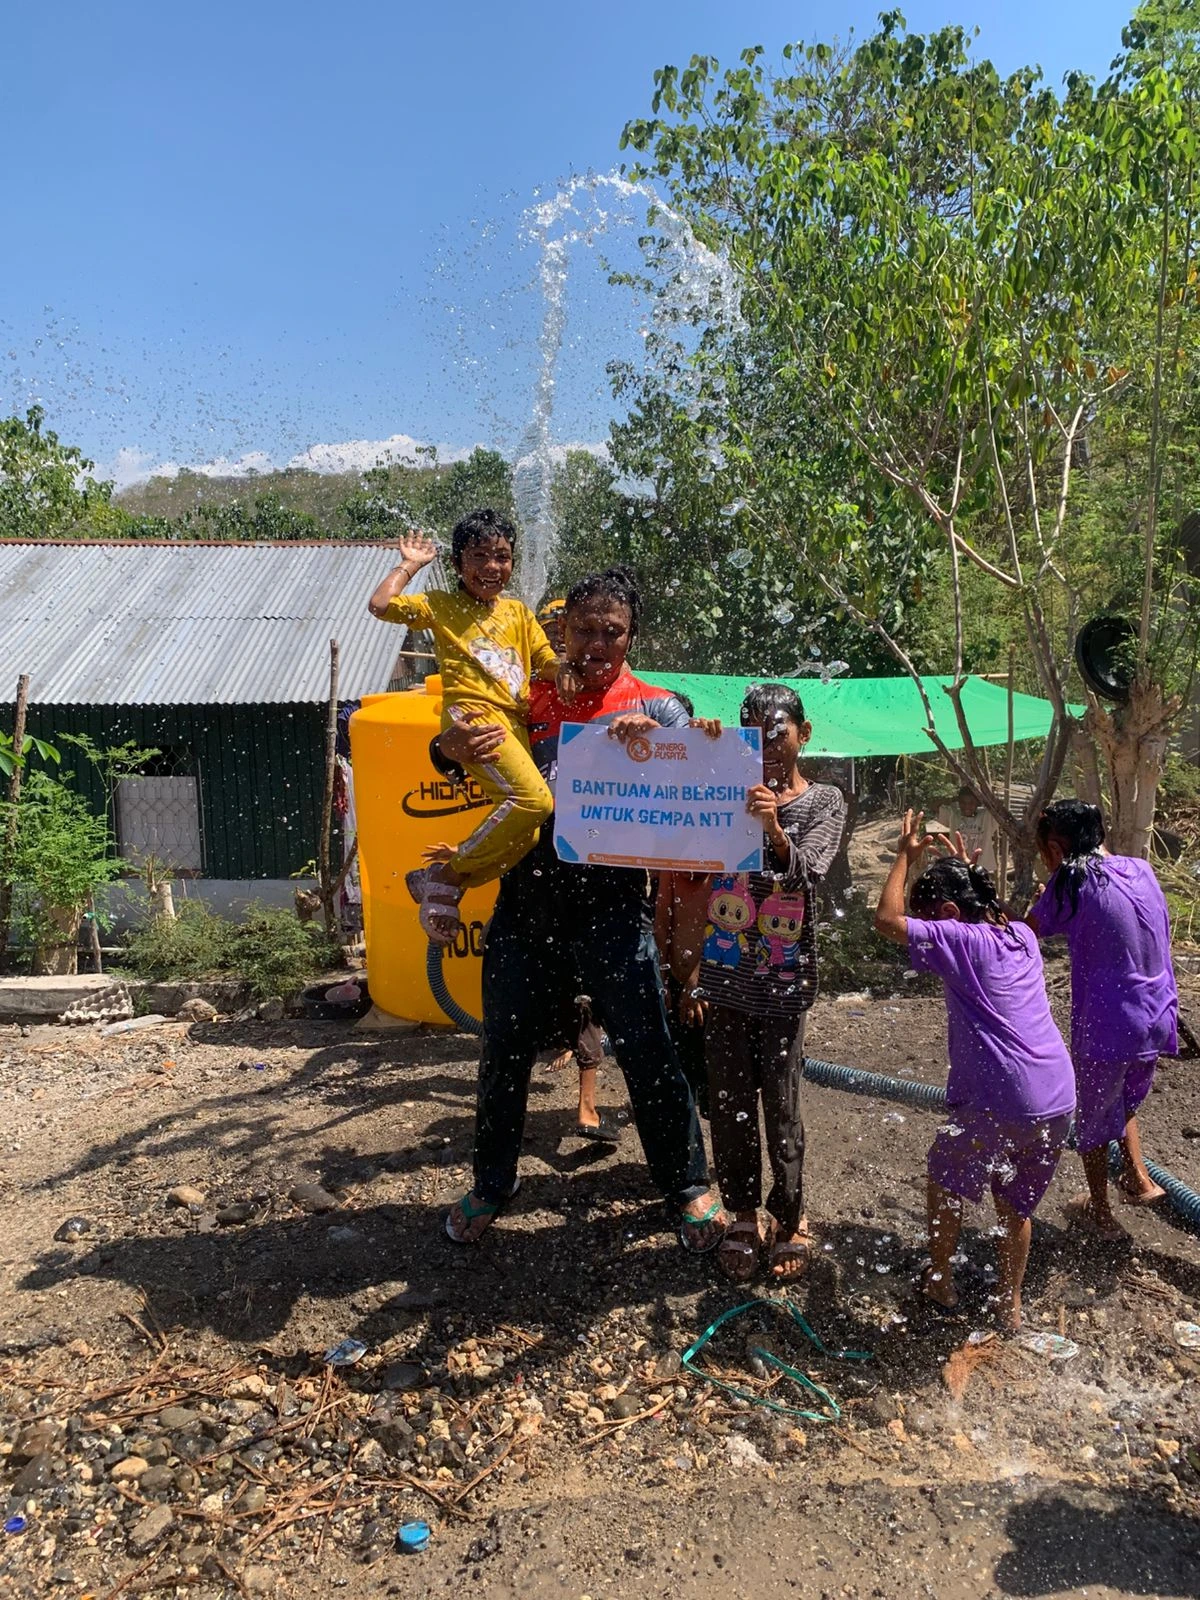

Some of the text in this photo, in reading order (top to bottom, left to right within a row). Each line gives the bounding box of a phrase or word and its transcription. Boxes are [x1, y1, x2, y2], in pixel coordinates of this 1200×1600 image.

[654, 751, 688, 760] PUSPITA
[572, 779, 746, 801] BANTUAN AIR BERSIH
[580, 804, 735, 827] UNTUK GEMPA NTT
